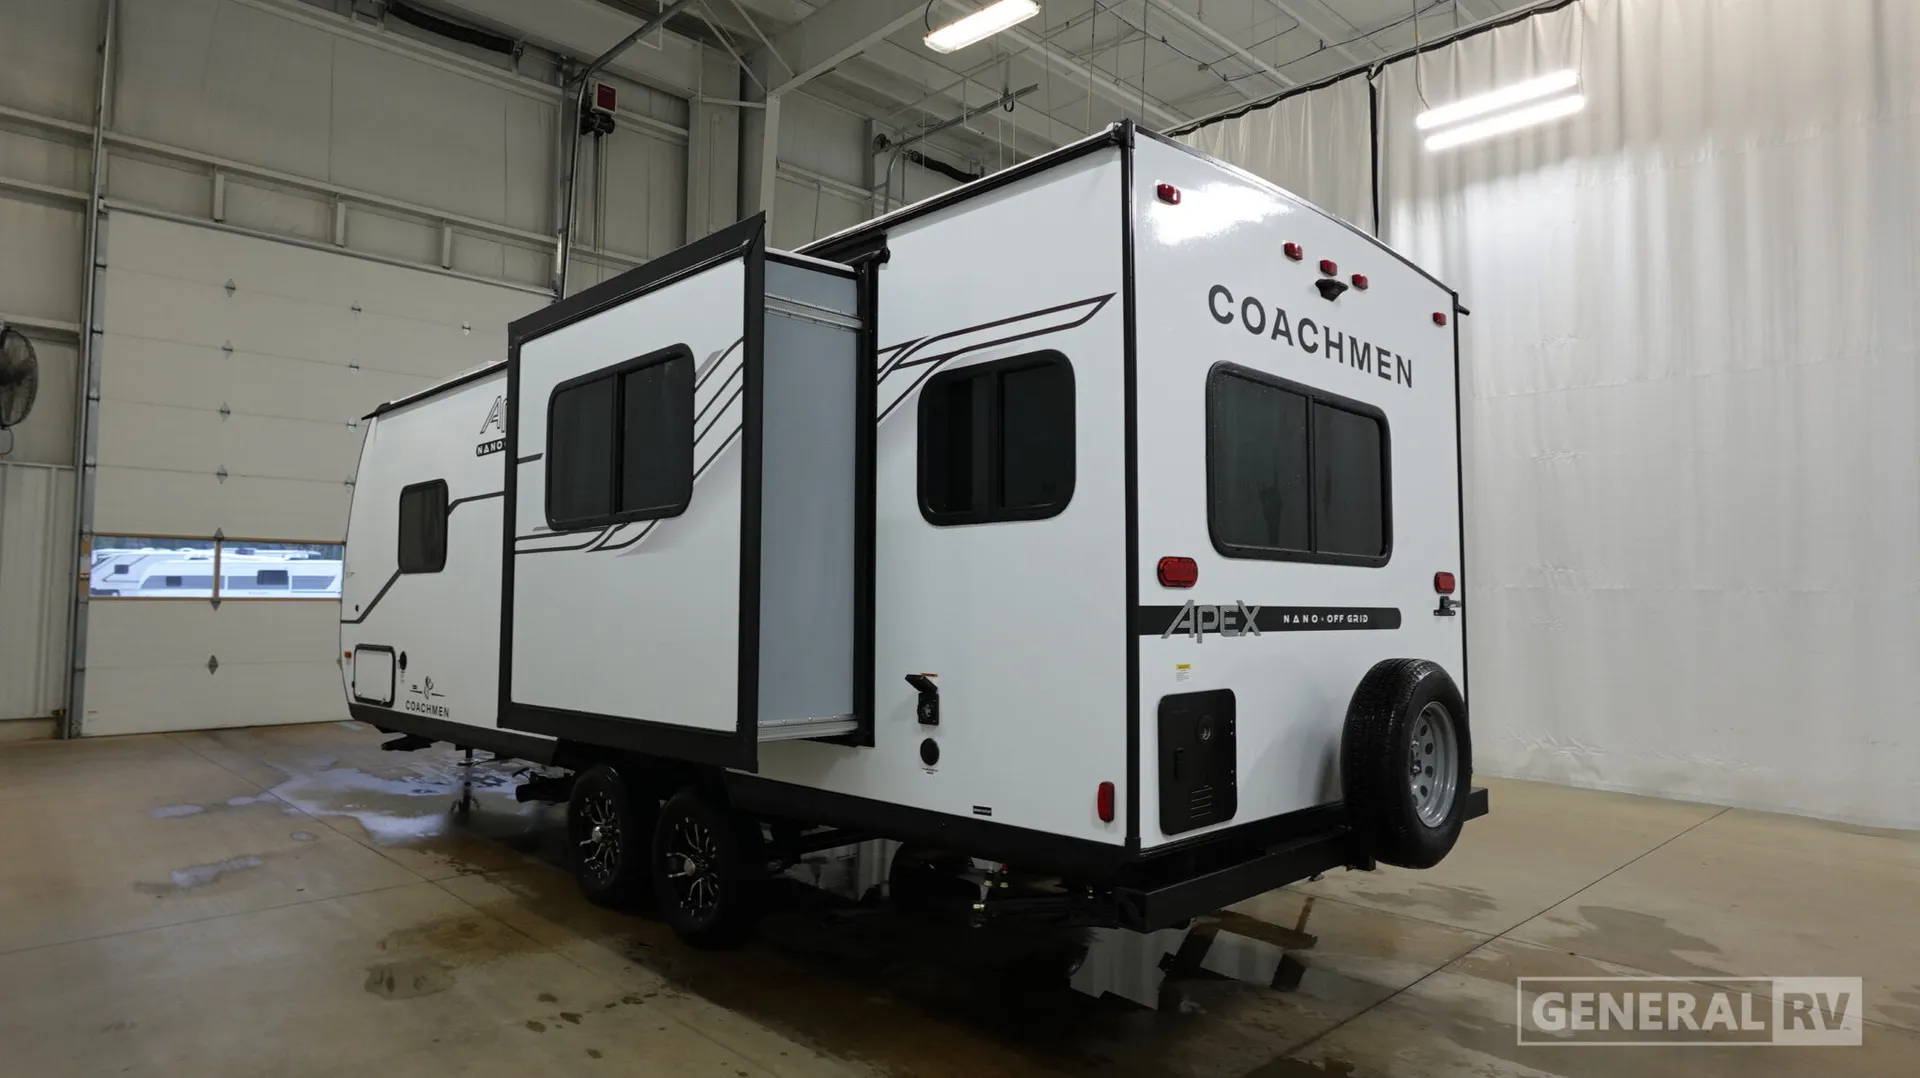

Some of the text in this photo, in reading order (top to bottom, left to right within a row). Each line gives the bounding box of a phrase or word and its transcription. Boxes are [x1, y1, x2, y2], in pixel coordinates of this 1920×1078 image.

[1208, 284, 1413, 388] COACHMEN
[1161, 599, 1262, 644] APEX
[1346, 614, 1369, 624] GRID
[405, 700, 450, 718] COACHMEN
